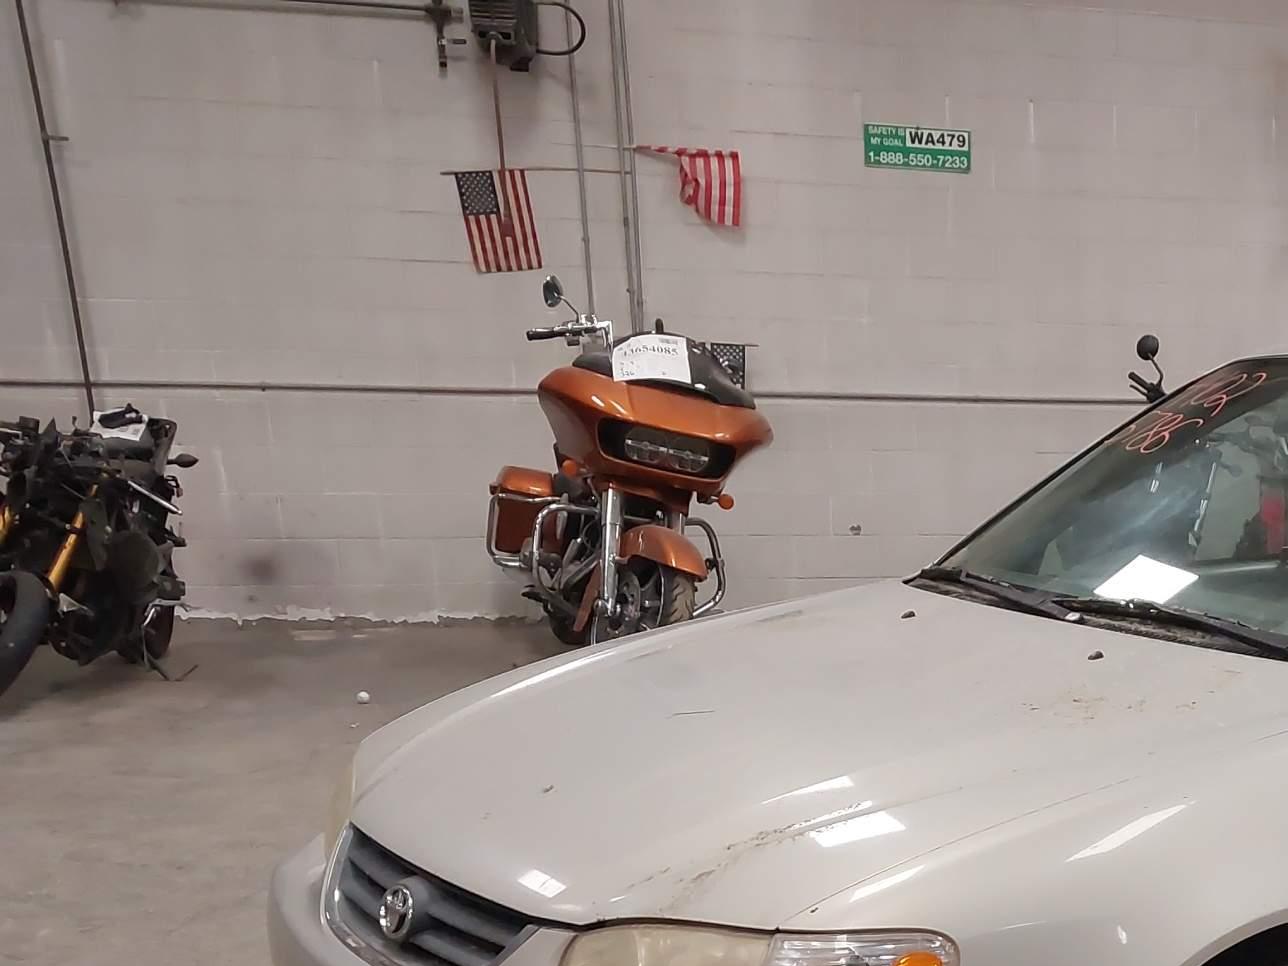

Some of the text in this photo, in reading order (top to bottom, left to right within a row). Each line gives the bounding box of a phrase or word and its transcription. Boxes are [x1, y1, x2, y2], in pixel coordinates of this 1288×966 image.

[868, 125, 905, 136] SAFETY IS
[870, 137, 903, 146] MY GOAL
[908, 130, 966, 149] WA479
[868, 151, 968, 169] 1-888-550-7233
